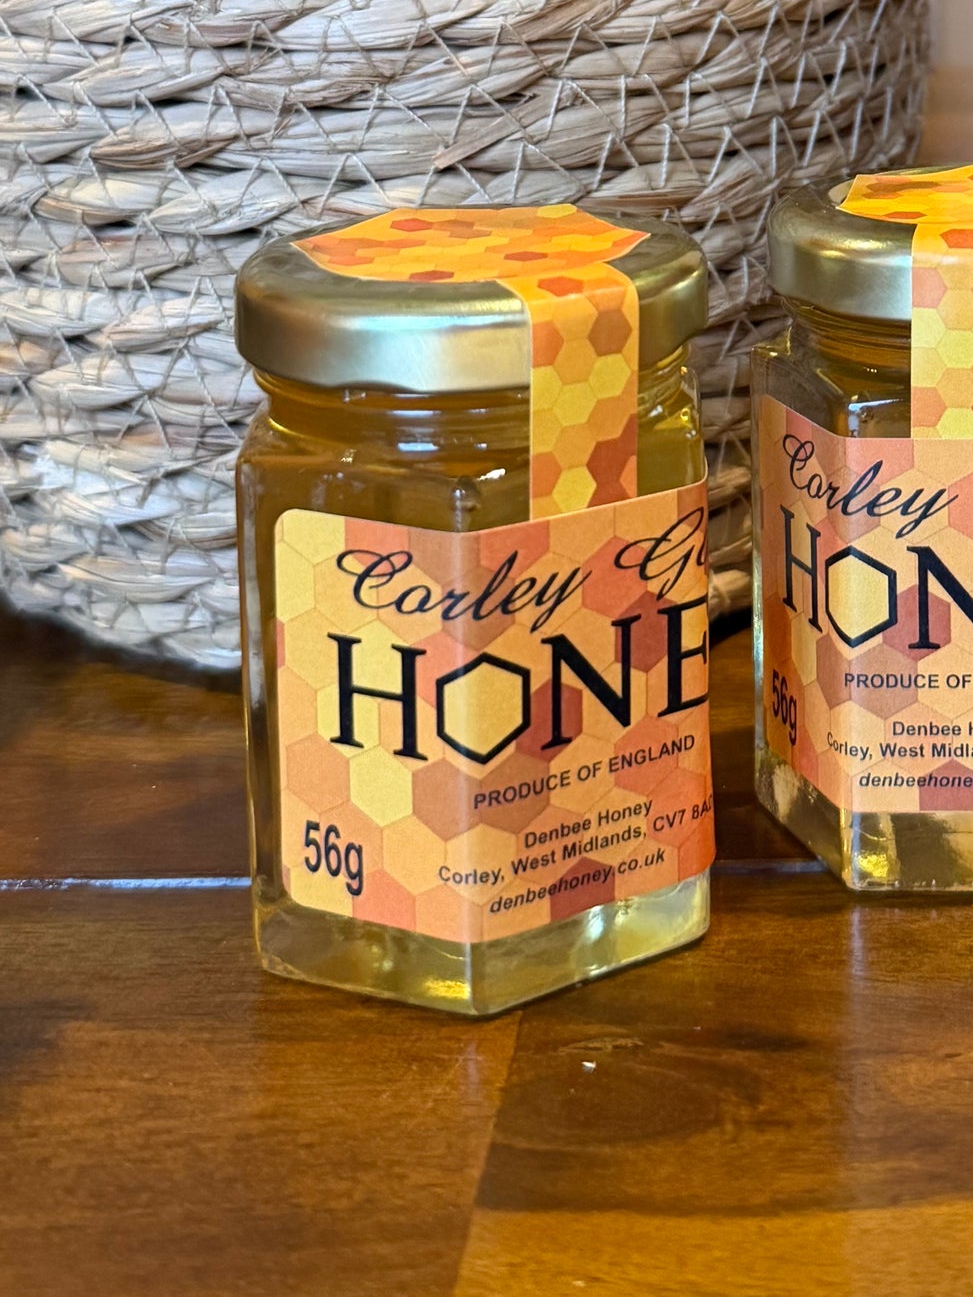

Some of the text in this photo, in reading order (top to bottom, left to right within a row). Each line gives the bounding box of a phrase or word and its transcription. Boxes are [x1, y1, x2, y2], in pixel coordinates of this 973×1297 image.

[782, 434, 958, 539] Corley
[336, 550, 592, 633] Corley
[772, 669, 797, 746] 56g
[844, 673, 940, 690] PRODUCE
[946, 673, 972, 690] OF
[827, 731, 873, 760] Corley,
[880, 743, 925, 759] West
[892, 721, 962, 737] Denbee
[474, 734, 696, 810] PRODUCE OF ENGLAND
[304, 820, 364, 896] 56g
[438, 860, 506, 887] Corley,
[511, 849, 557, 876] West
[562, 826, 648, 862] Midlands,
[653, 808, 687, 832] CV7
[524, 799, 653, 849] Denbee Honey
[489, 849, 666, 914] denbeehoney.co.uk
